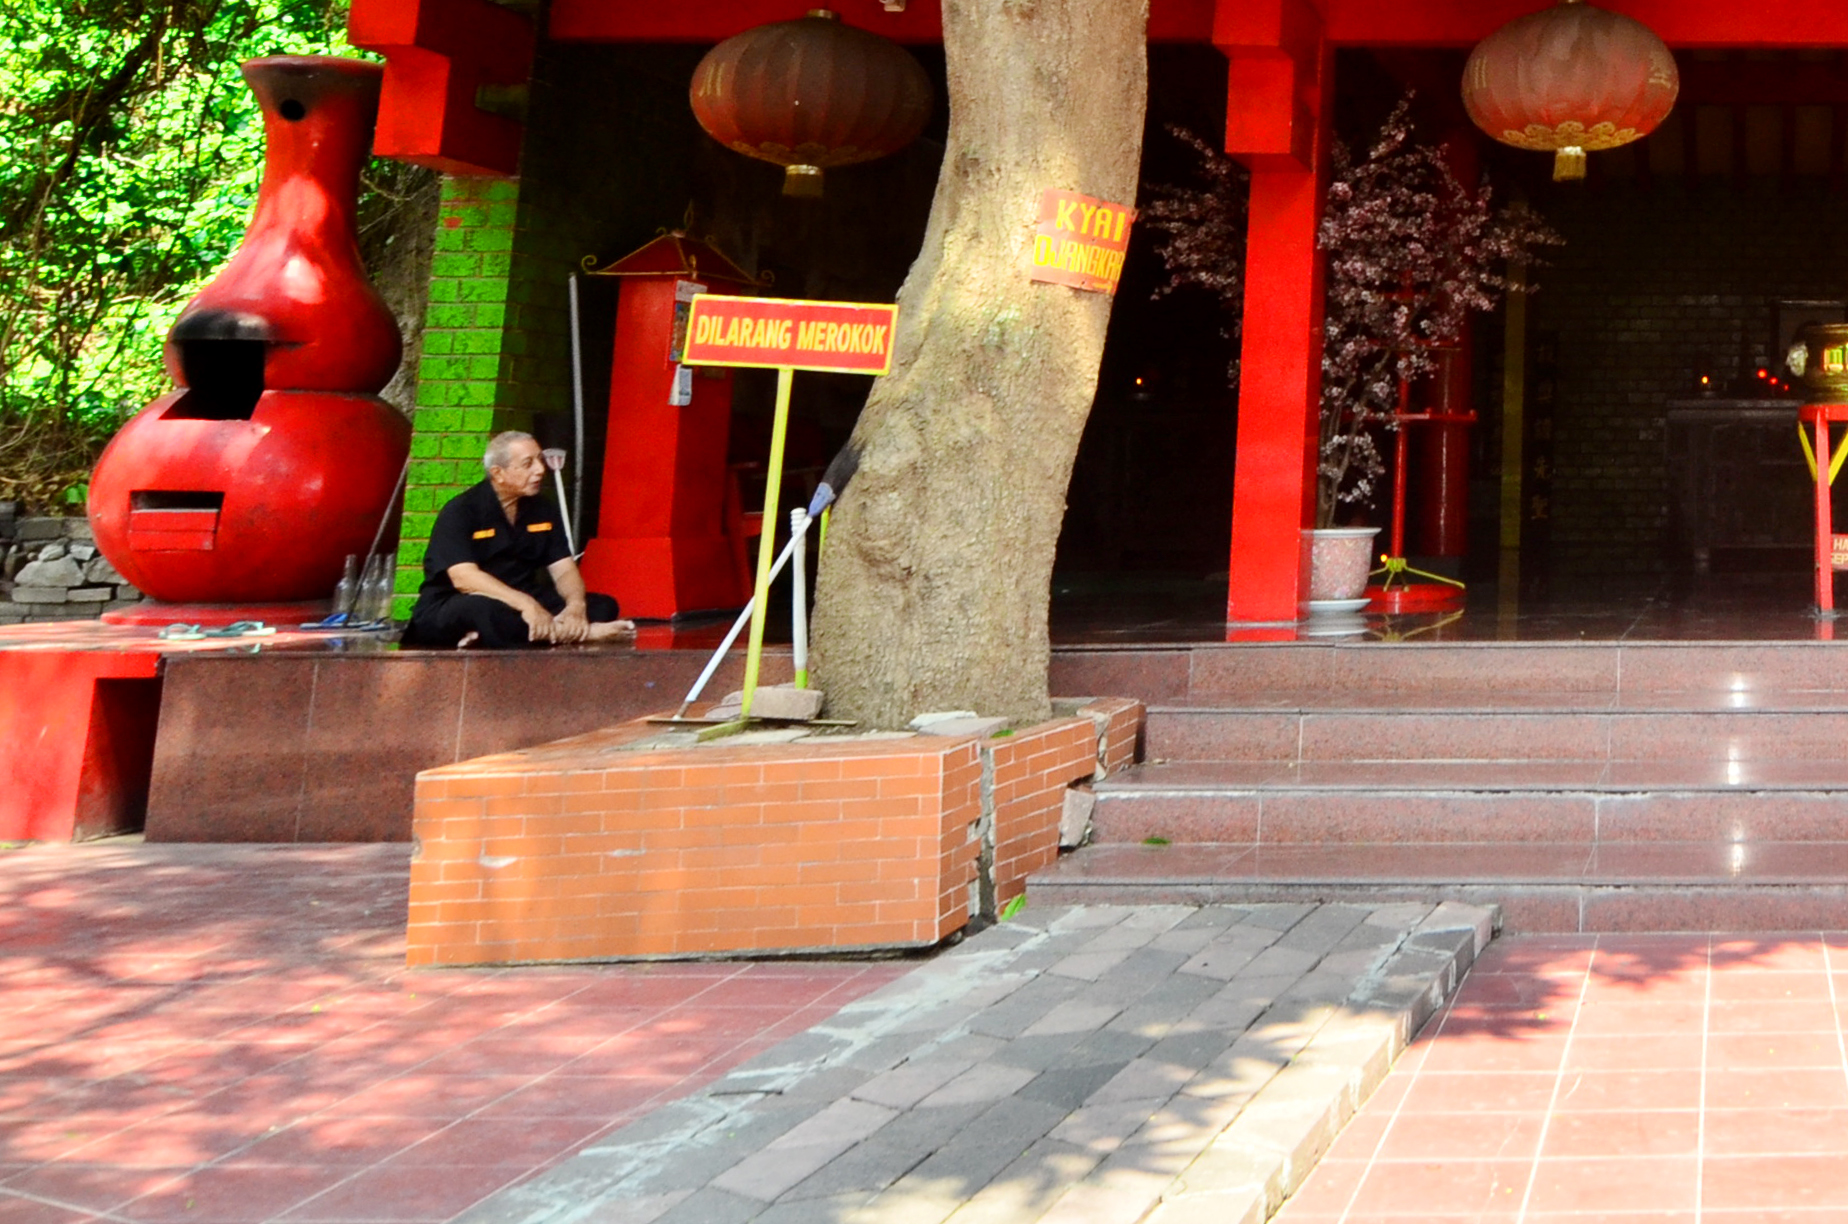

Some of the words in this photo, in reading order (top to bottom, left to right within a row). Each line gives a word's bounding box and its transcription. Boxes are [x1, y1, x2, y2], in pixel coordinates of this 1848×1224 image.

[1056, 199, 1126, 242] KYAI
[695, 315, 792, 350] DILARANG
[796, 321, 887, 355] MEROKOK
